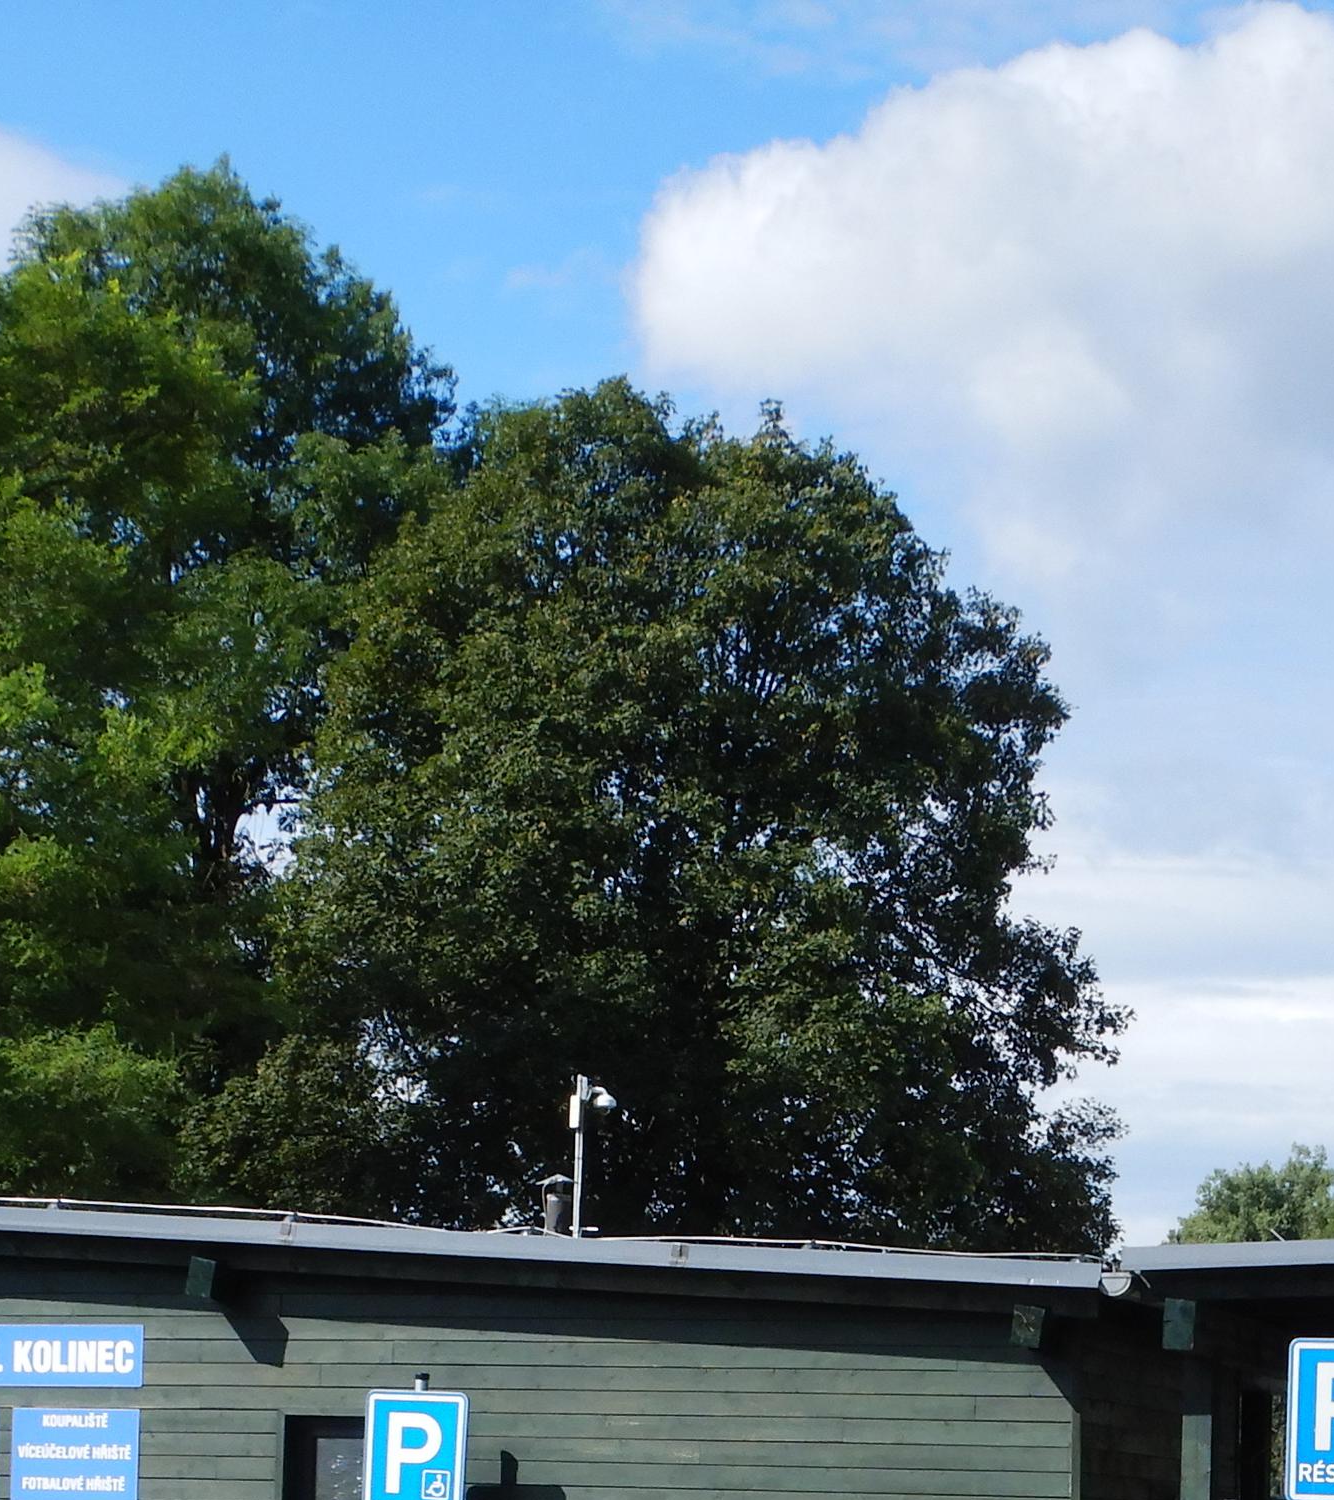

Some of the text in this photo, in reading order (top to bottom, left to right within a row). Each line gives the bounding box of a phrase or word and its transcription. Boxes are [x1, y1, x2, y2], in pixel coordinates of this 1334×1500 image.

[13, 1340, 135, 1373] KOLINEC
[43, 1413, 108, 1428] KOUPALIŠTĚ
[18, 1443, 131, 1460] VÍCEÚČELOVÉ HŘIŠTĚ
[385, 1412, 443, 1494] P
[22, 1476, 125, 1491] FOTBALOVÉ HŘIŠTĚ
